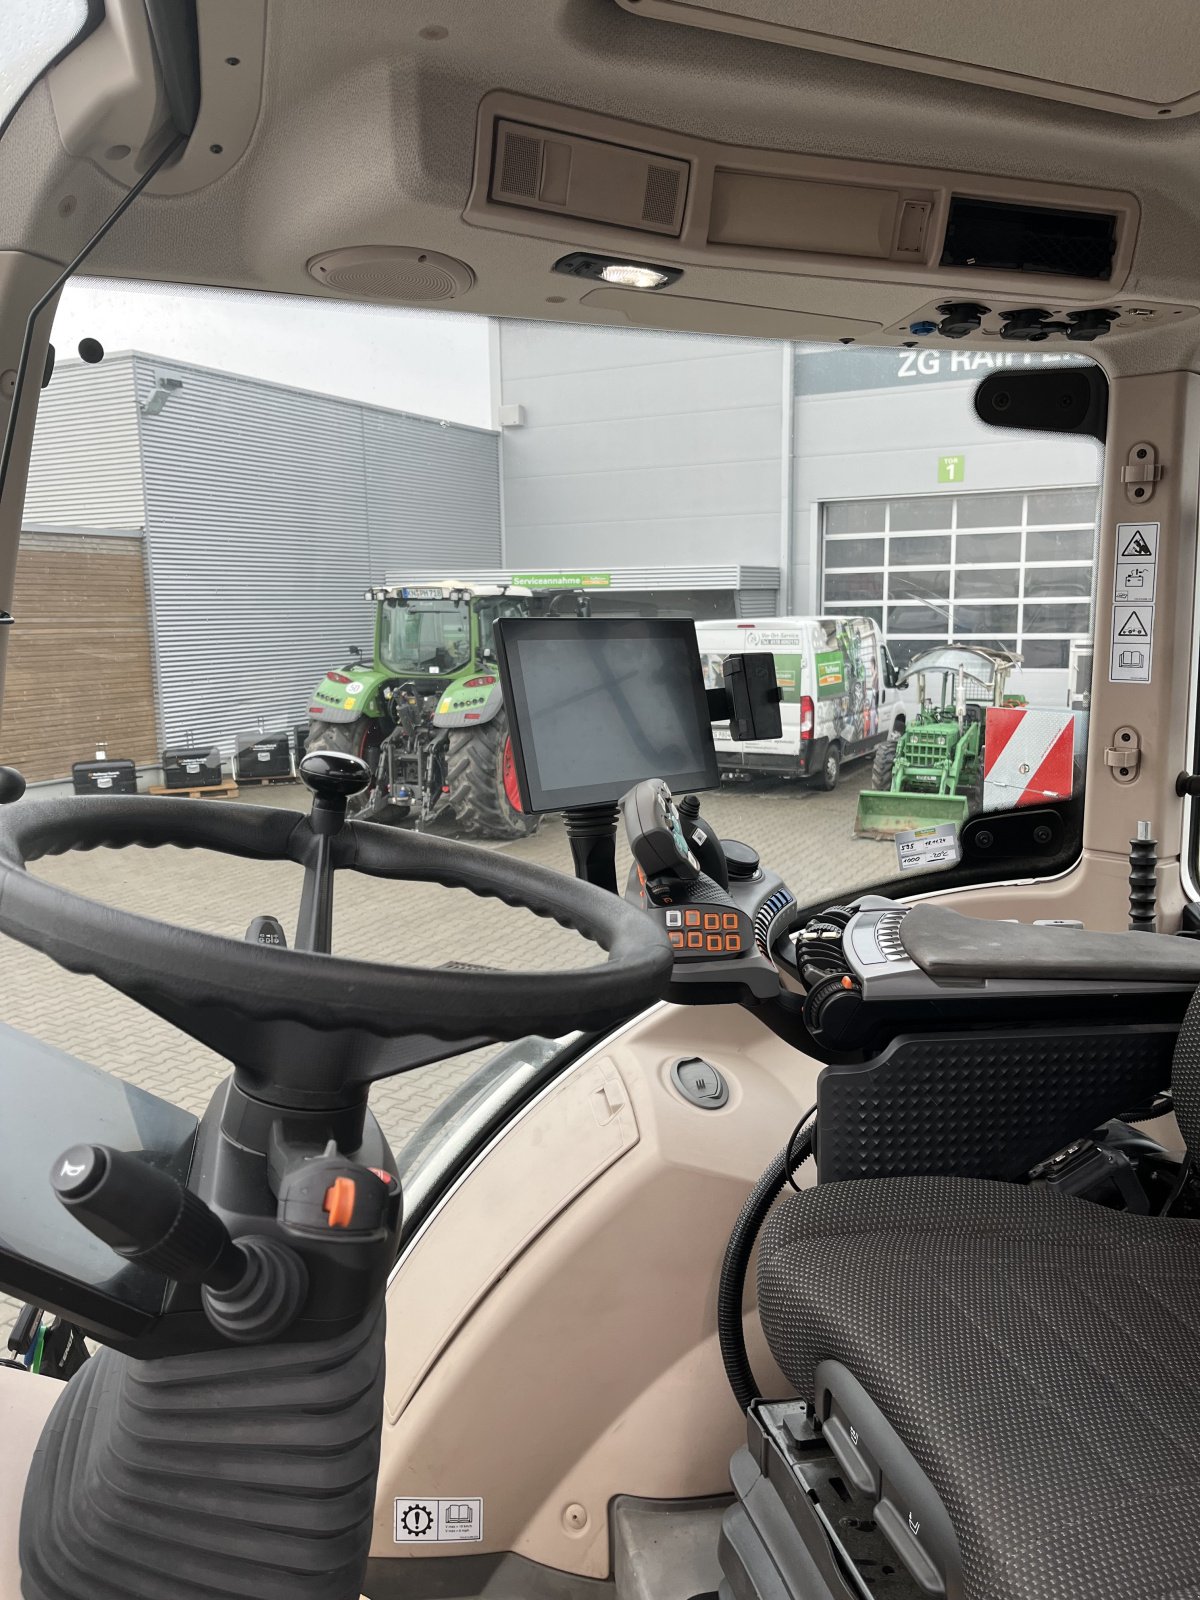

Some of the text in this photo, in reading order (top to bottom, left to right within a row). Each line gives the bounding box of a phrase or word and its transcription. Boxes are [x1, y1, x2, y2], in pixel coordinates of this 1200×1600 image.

[897, 350, 940, 377] ZG
[943, 457, 959, 465] TOR
[945, 464, 955, 480] 1
[513, 577, 581, 585] Serviceannahme
